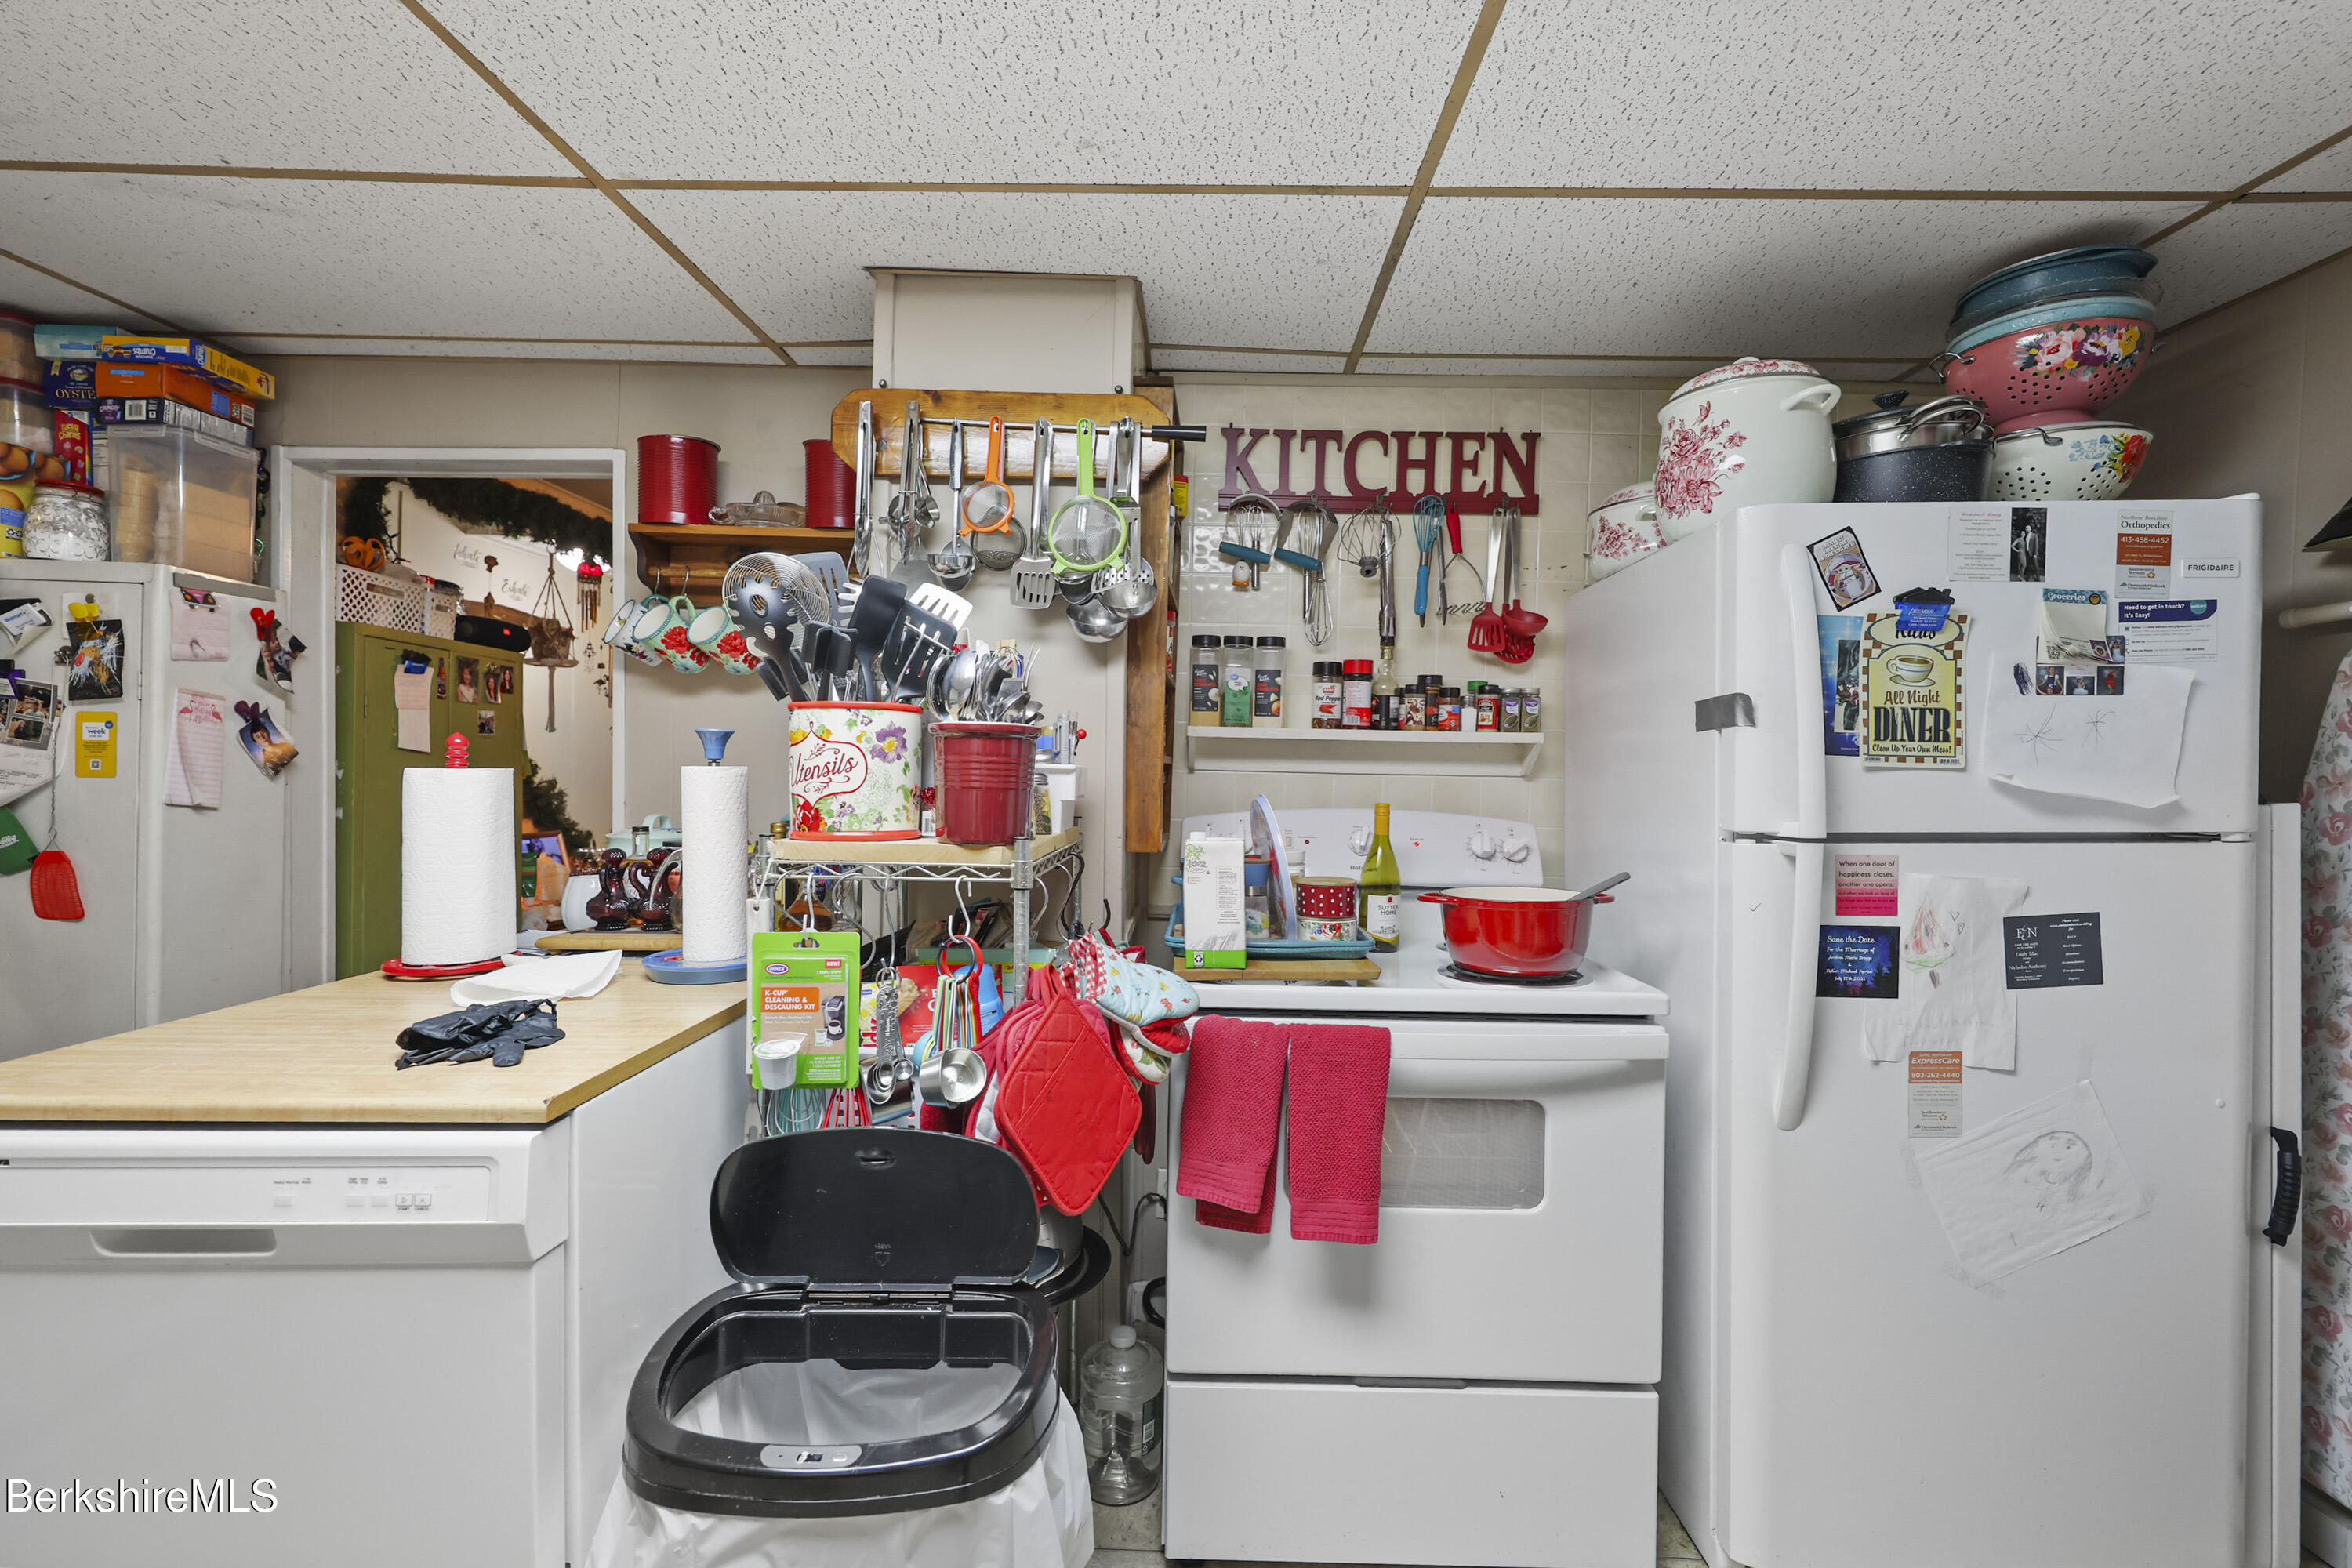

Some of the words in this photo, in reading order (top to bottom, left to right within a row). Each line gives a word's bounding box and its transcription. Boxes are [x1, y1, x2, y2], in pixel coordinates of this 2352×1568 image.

[56, 388, 99, 400] OYSTE
[1221, 427, 1542, 498] KITCHEN
[2121, 521, 2170, 530] Orthopedics
[2047, 591, 2086, 601] Groceries
[1884, 690, 1904, 706] All
[1907, 689, 1941, 707] Night
[1873, 706, 1951, 743] DINER
[1872, 744, 1890, 753] Clean
[1932, 745, 1951, 753] Mess!
[789, 752, 858, 788] Utensils
